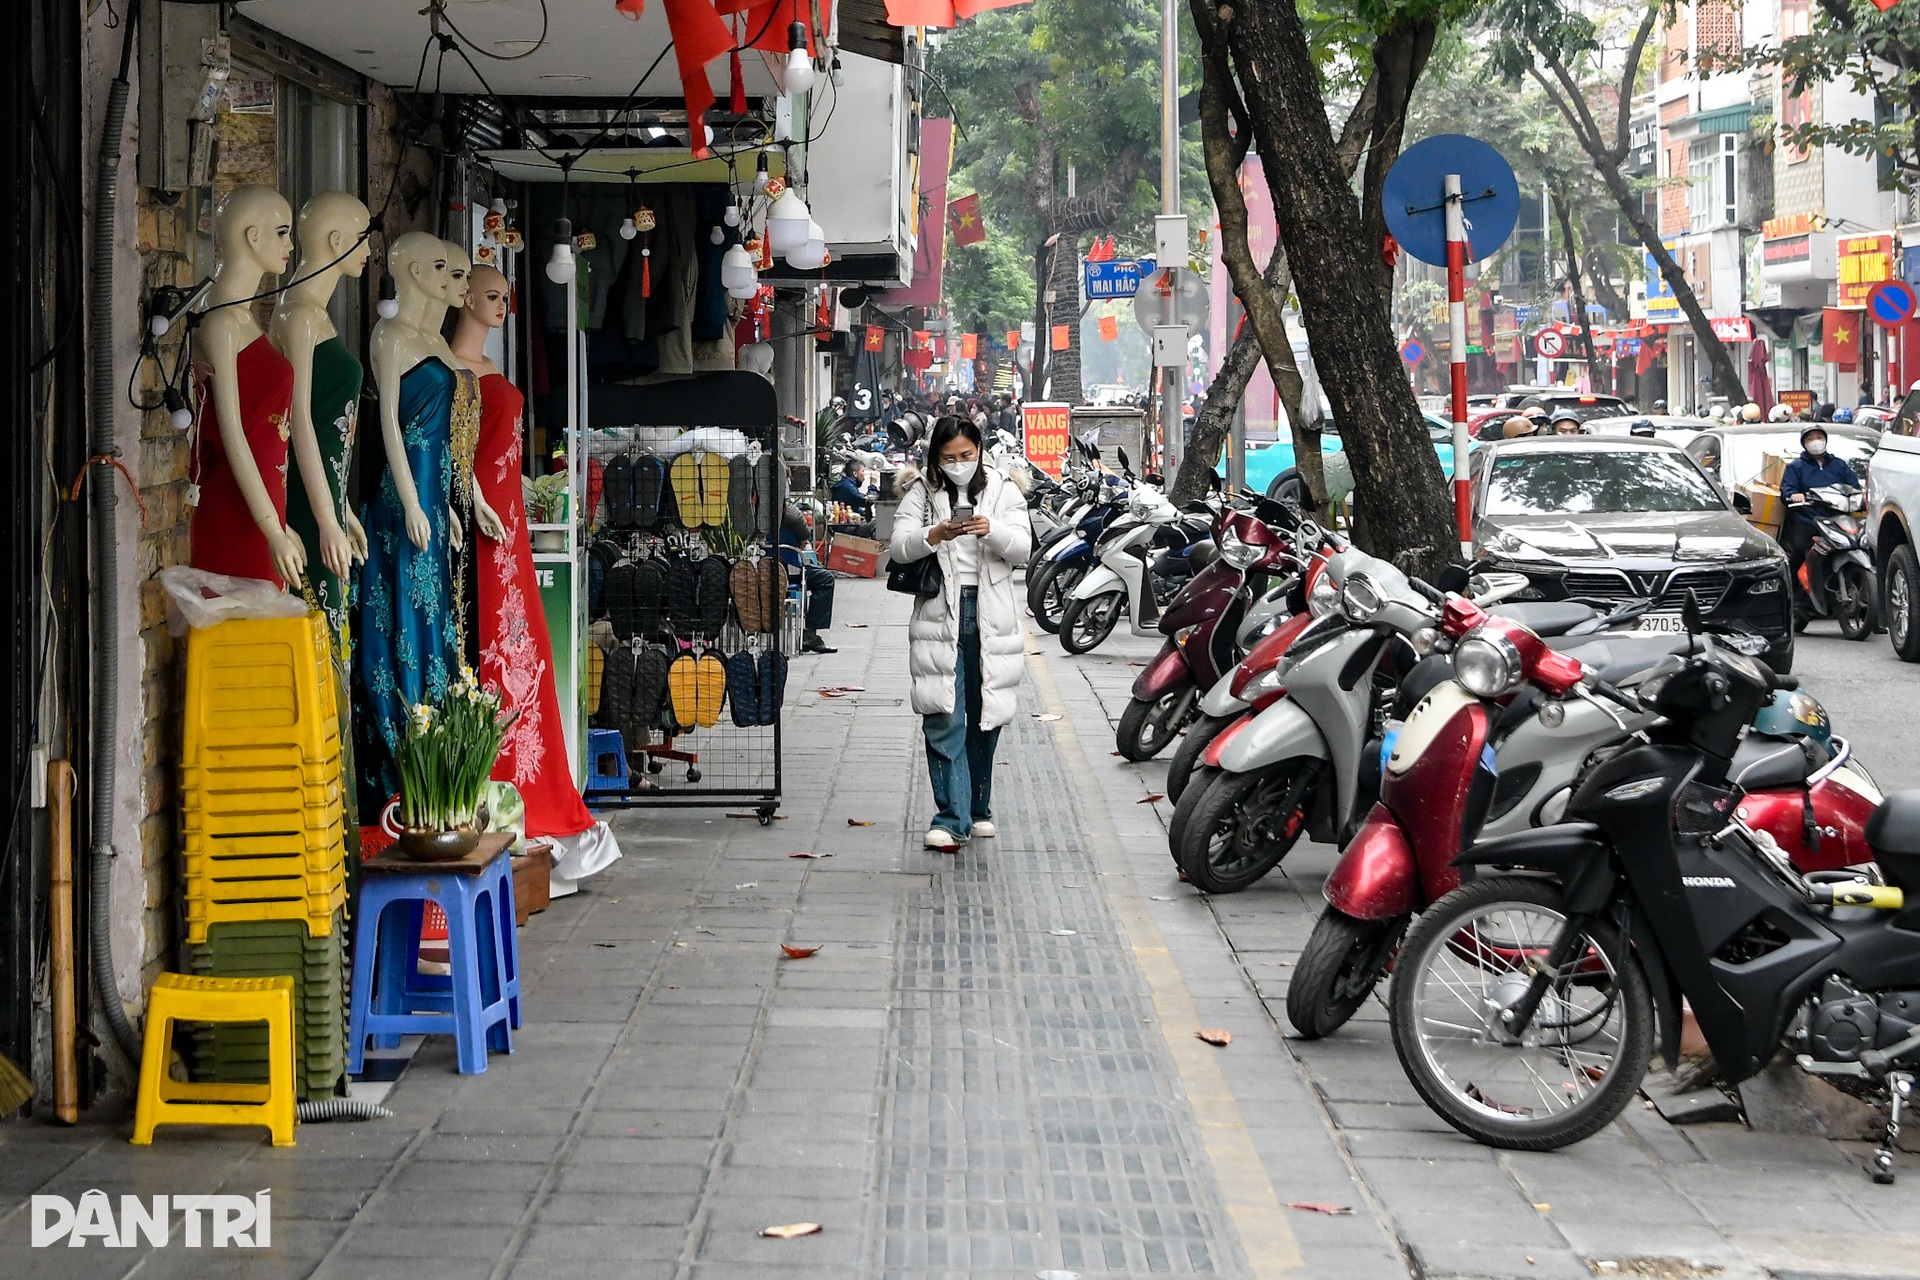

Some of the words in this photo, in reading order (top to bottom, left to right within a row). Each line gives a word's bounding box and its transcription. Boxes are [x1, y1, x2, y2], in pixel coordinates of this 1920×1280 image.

[1092, 279, 1112, 293] MAI
[1115, 274, 1136, 292] HẮC
[1026, 410, 1067, 430] VÀNG
[1028, 434, 1065, 456] 9999
[1681, 876, 1737, 888] HONDA
